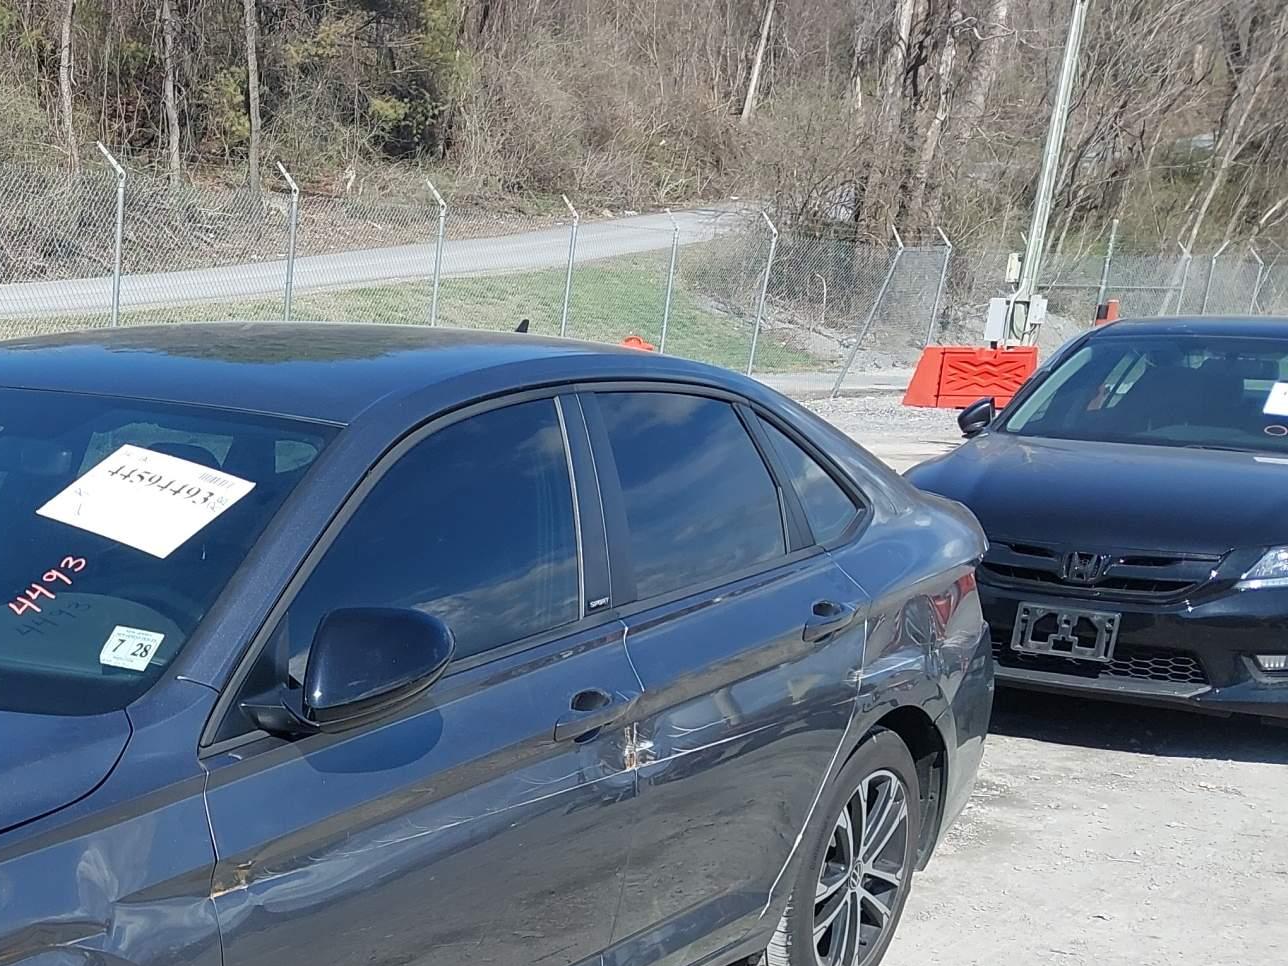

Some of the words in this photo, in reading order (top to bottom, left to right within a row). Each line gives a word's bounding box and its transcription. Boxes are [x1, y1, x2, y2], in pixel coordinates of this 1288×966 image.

[107, 464, 215, 504] 44594493
[8, 555, 86, 616] 4493
[112, 638, 127, 653] 7
[130, 642, 152, 658] 28
